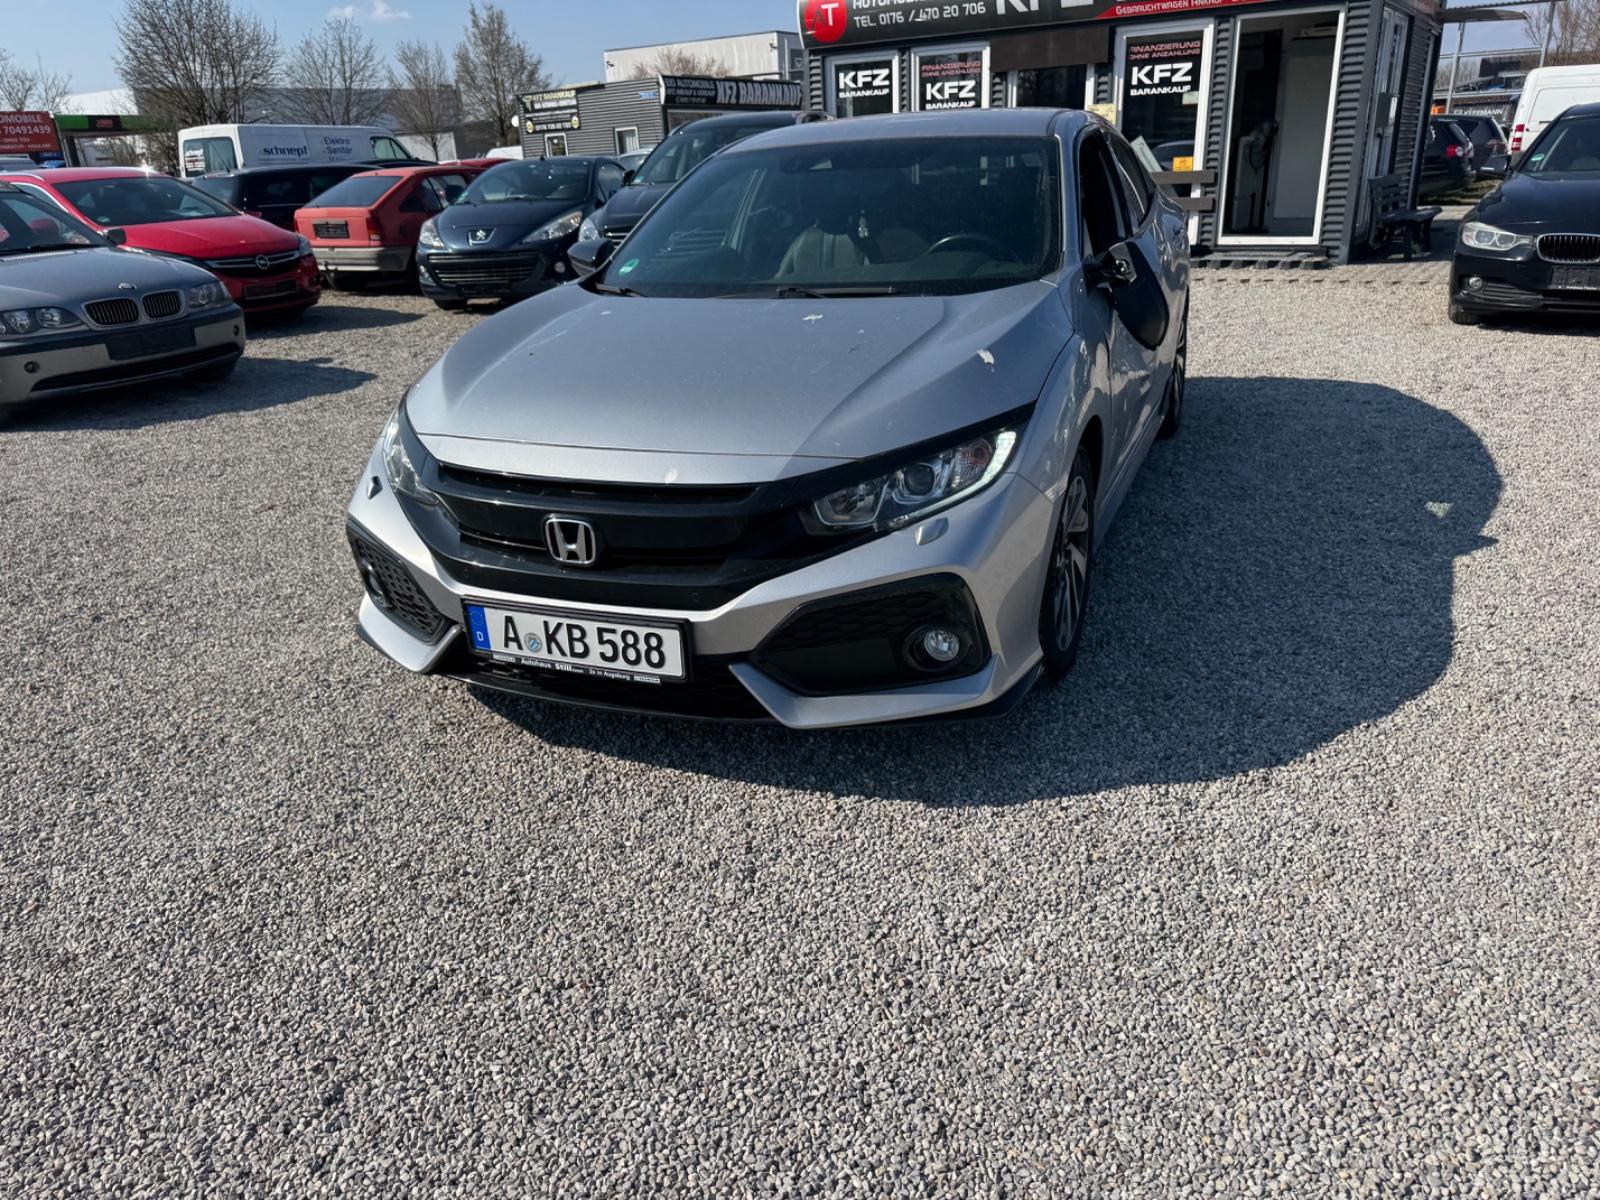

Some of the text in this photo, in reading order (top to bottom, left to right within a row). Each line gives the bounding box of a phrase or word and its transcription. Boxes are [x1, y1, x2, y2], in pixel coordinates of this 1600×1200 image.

[853, 15, 877, 28] TEL.
[879, 11, 904, 25] 0176
[919, 7, 940, 20] 470
[943, 5, 959, 18] 20
[962, 2, 986, 16] 706
[1130, 40, 1201, 53] FINANZIERUNG
[1151, 49, 1200, 58] ANZAHLUNG
[921, 60, 981, 72] FINANZIERUNG
[838, 68, 890, 89] KFZ
[1131, 62, 1193, 85] KFZ
[716, 80, 737, 104] KFZ
[838, 88, 890, 98] BARANKAUF
[926, 79, 976, 101] KFZ
[1130, 85, 1192, 96] BARANKAUF
[925, 100, 976, 110] BARANKAUF
[2, 125, 51, 135] 70491439
[324, 136, 351, 145] Elektro
[263, 145, 309, 157] schnepf
[476, 631, 484, 641] D
[504, 615, 666, 669] A KB 588
[521, 657, 552, 669] Autohaus
[603, 671, 631, 681] Augsburg
